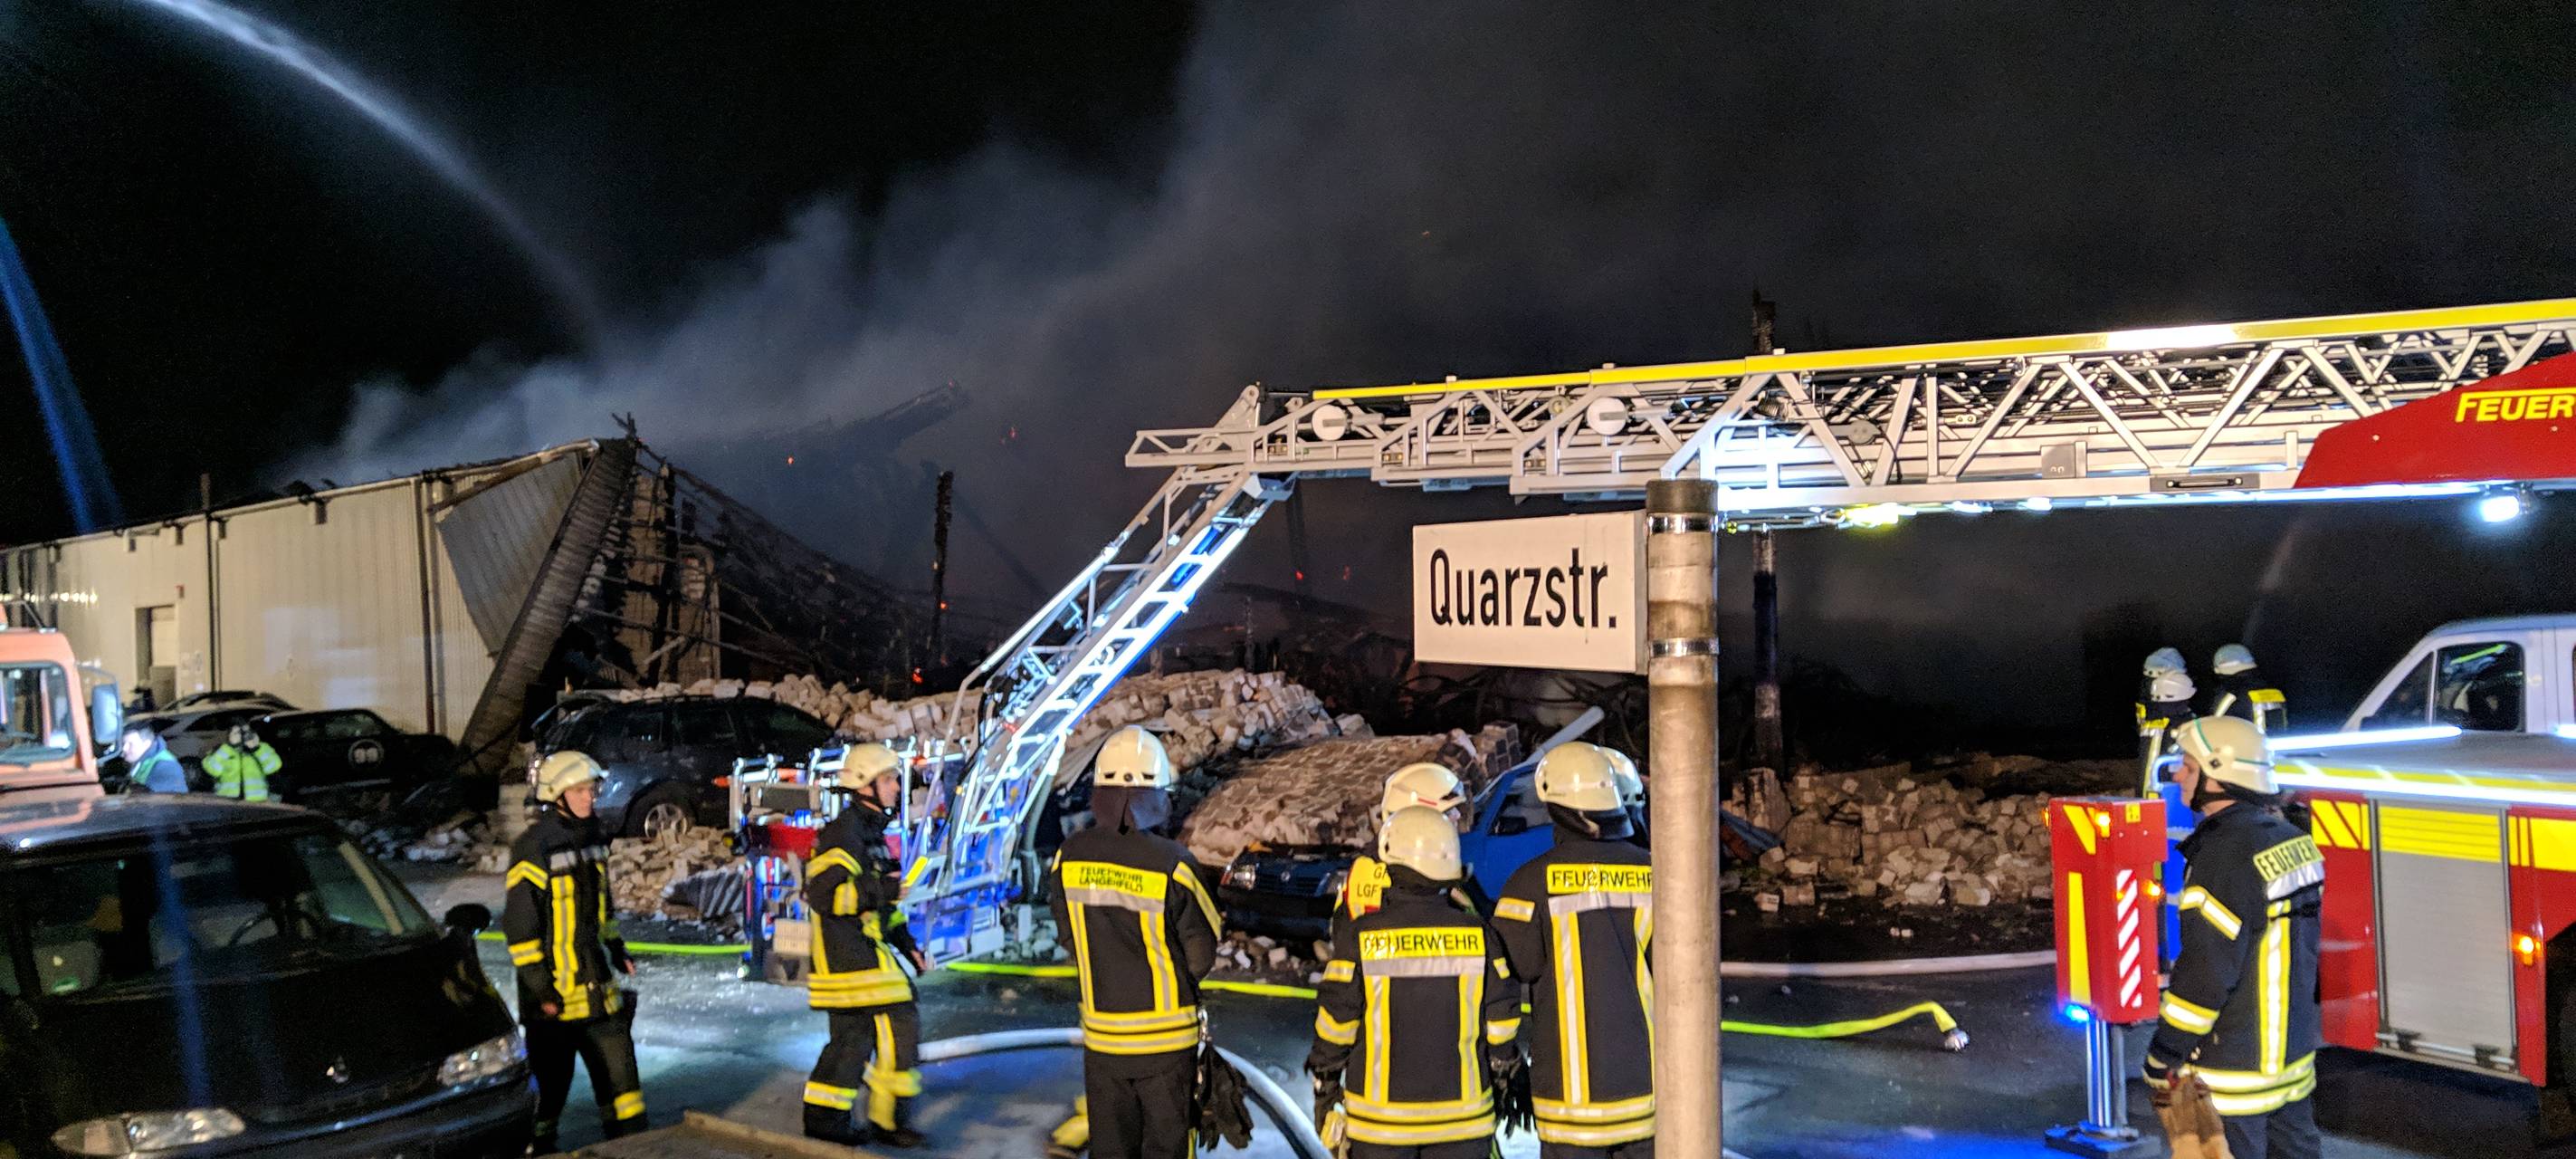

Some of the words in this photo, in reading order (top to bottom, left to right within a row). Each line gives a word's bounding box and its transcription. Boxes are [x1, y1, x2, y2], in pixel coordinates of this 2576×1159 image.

[2455, 387, 2575, 423] FEUER
[1430, 548, 1617, 628] Quarzstr.
[1364, 934, 1479, 956] FEUERWEHR
